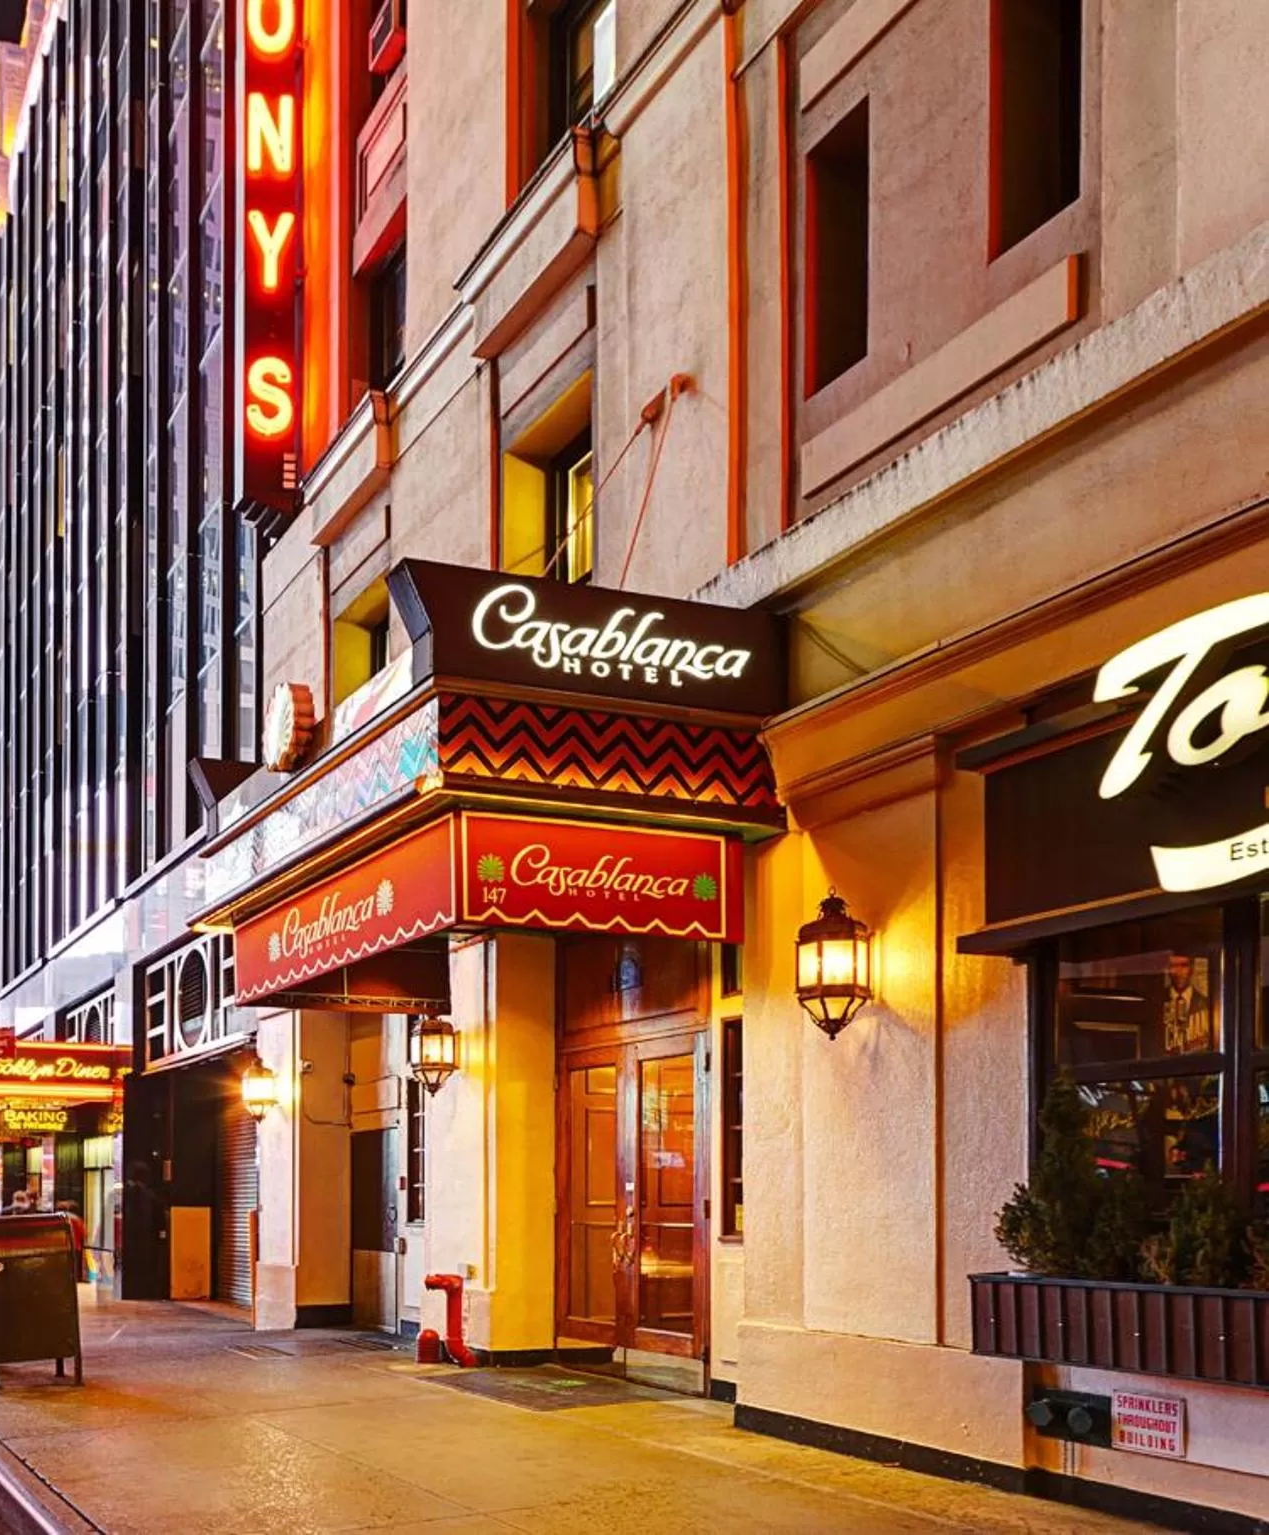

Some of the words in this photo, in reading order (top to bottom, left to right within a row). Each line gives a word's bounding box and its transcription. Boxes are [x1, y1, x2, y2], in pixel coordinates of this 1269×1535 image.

[472, 583, 751, 680] Casablanca
[562, 656, 684, 687] HOTEL
[510, 843, 689, 899] Casablanca
[482, 886, 507, 904] 147
[568, 887, 641, 902] HOTEL
[281, 891, 375, 959] Casablanca
[55, 1056, 111, 1080] Diner
[4, 1109, 68, 1123] BAKING
[1117, 1394, 1179, 1417] SPRINKLERS
[1119, 1430, 1176, 1451] BUILDING
